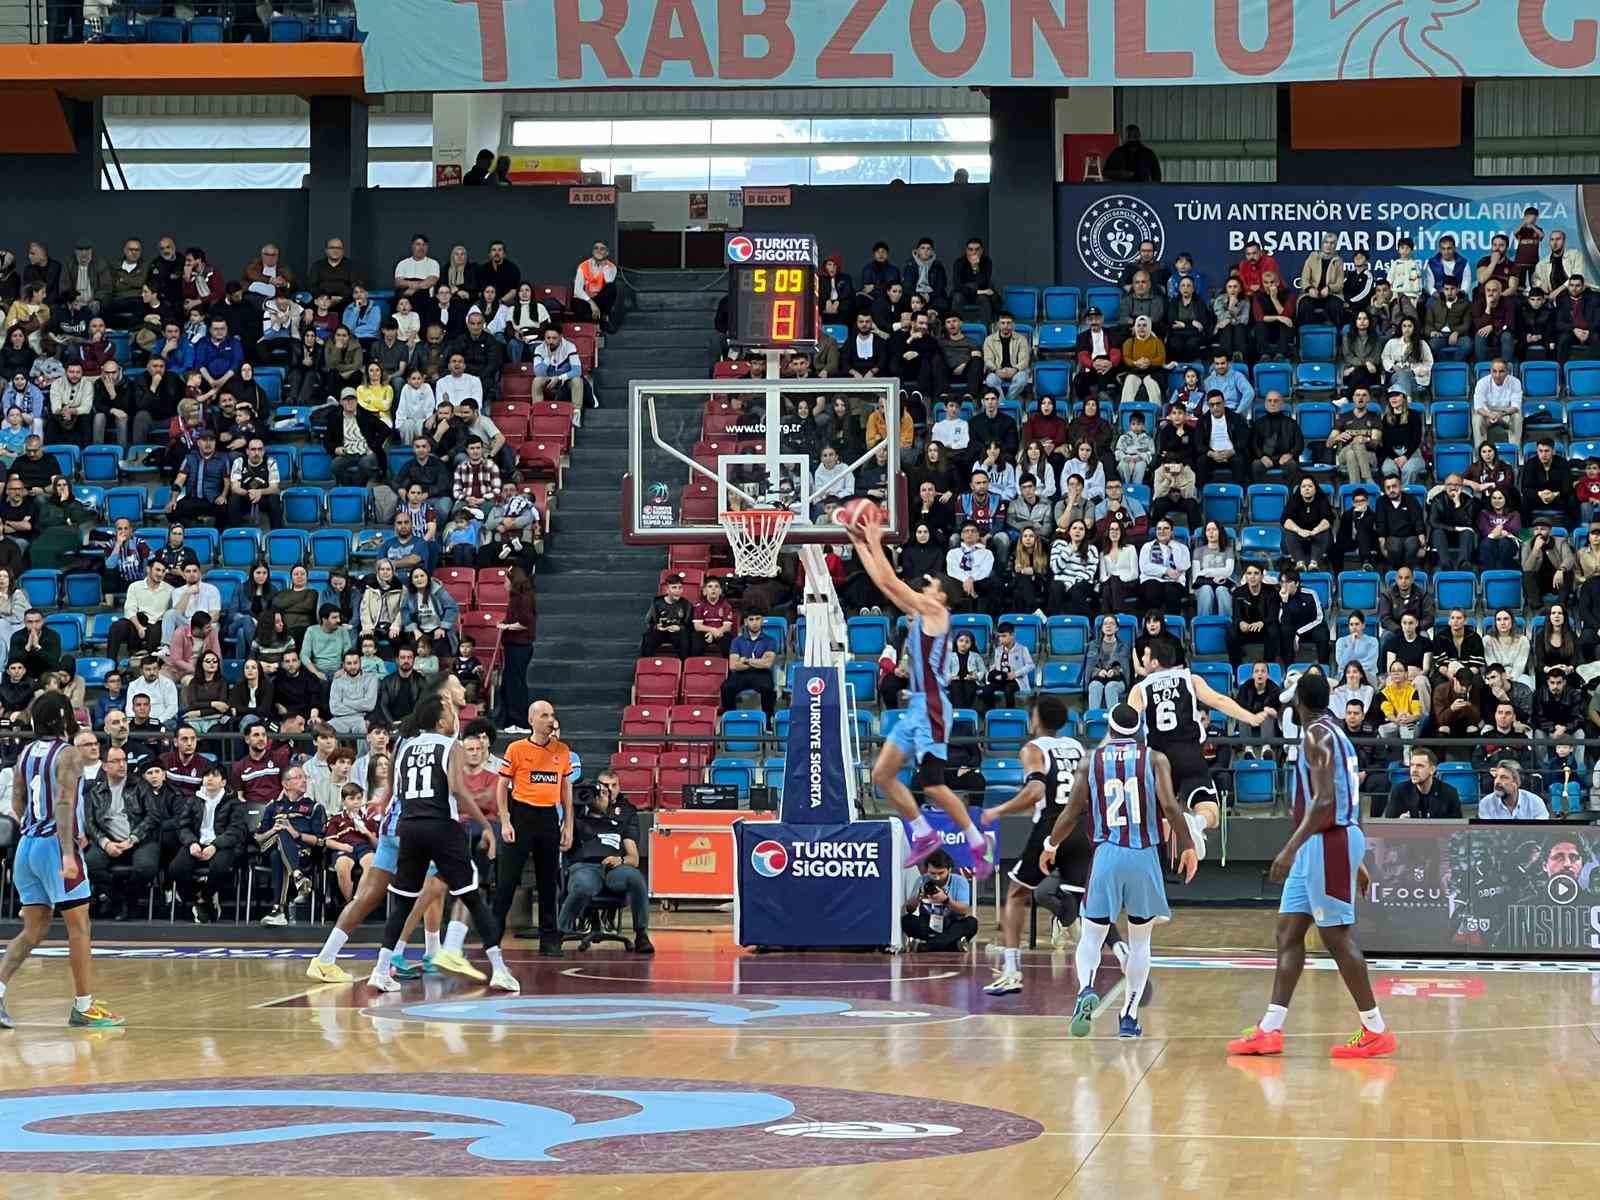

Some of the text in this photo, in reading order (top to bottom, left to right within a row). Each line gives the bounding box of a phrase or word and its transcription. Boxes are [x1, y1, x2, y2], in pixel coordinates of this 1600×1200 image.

[573, 193, 611, 202] A BLOK
[757, 194, 786, 204] BLOK
[1174, 200, 1221, 221] TÜM
[1227, 199, 1342, 221] ANTRENÖR
[1345, 203, 1372, 221] VE
[754, 269, 802, 293] 5 09
[772, 299, 796, 340] 8
[1156, 699, 1178, 732] 6
[405, 766, 435, 800] 11
[1104, 776, 1141, 828] 21
